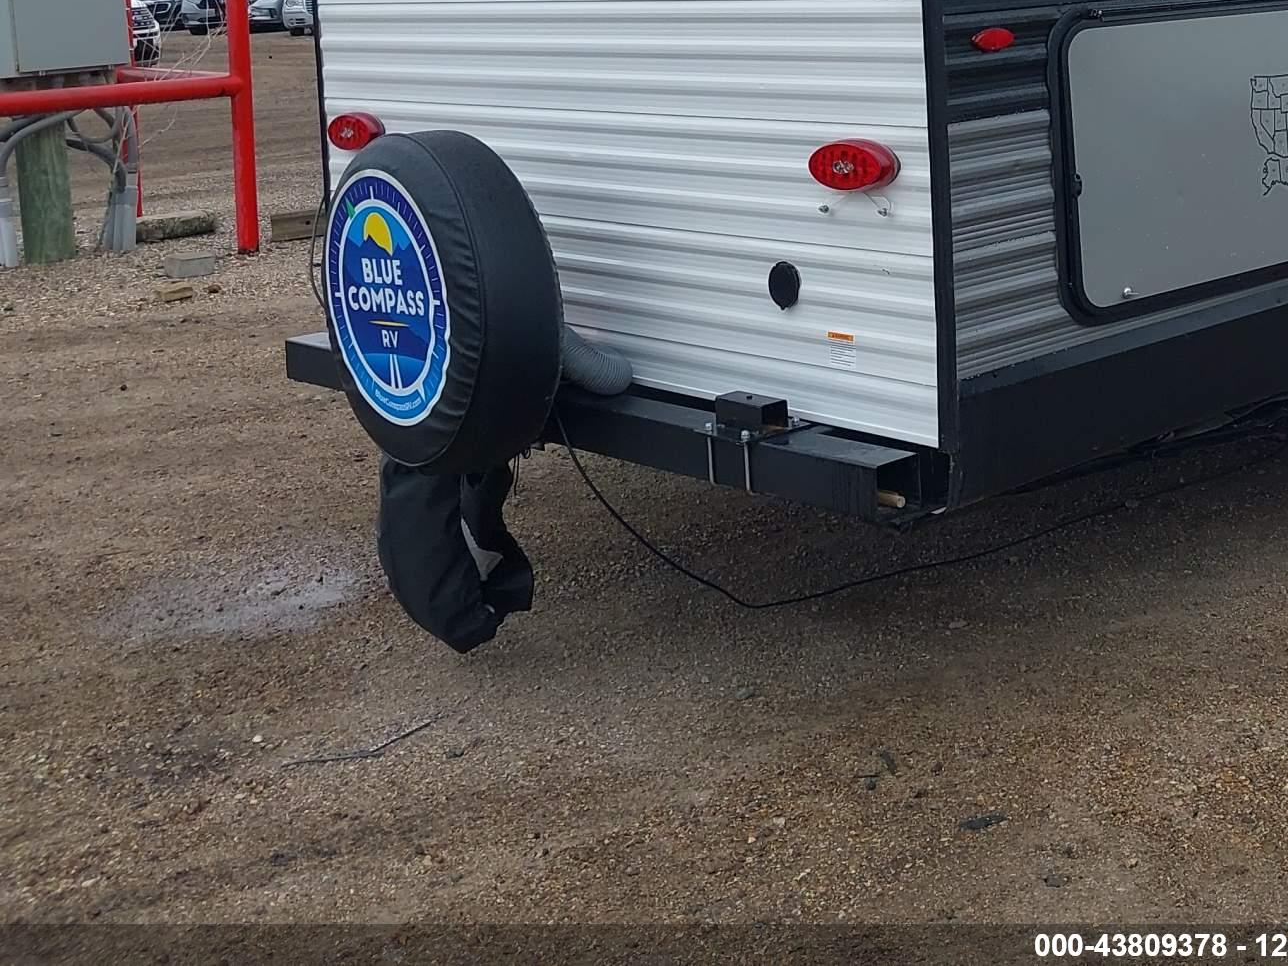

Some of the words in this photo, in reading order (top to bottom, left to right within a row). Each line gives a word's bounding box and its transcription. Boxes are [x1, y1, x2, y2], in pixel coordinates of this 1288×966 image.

[361, 257, 403, 285] BLUE
[348, 285, 425, 316] COMPASS
[381, 330, 399, 349] RV
